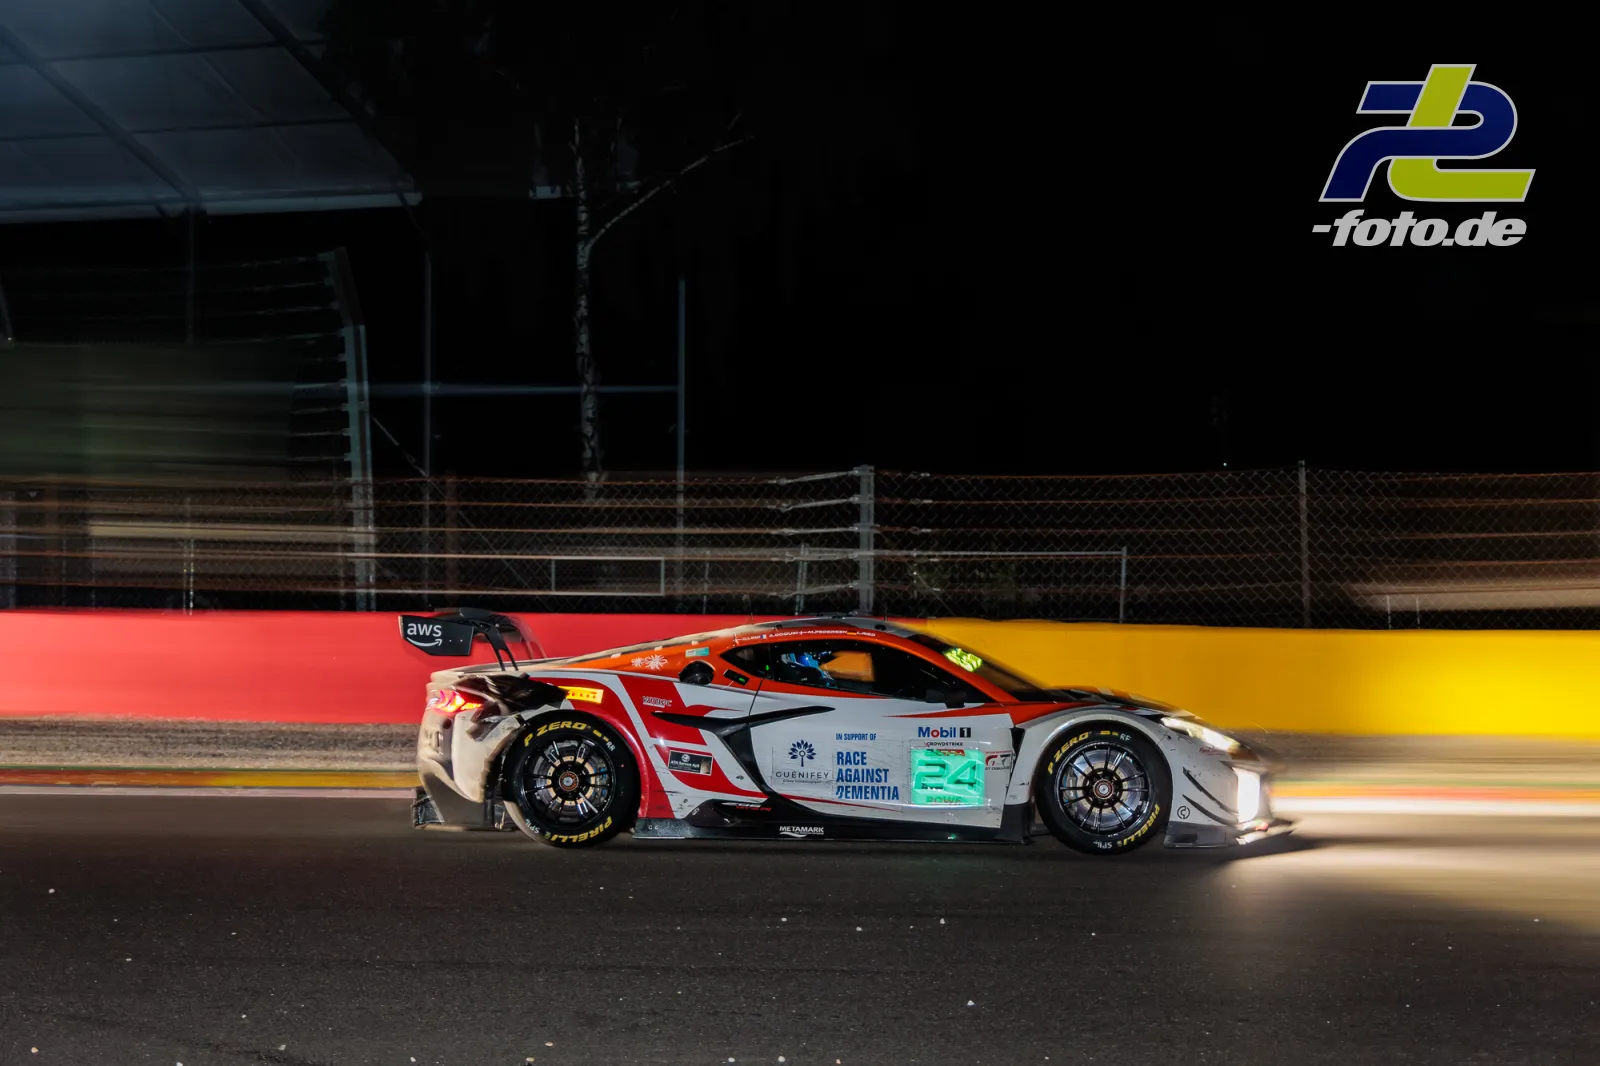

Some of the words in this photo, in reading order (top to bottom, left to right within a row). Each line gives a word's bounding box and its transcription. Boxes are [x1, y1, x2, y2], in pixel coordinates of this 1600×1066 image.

[407, 623, 442, 637] aws
[536, 721, 588, 737] ZERO
[918, 726, 956, 738] Mobil
[961, 727, 971, 738] 1
[1053, 731, 1089, 762] ZERO
[836, 751, 867, 766] RACE
[836, 768, 889, 783] AGAINST
[913, 759, 976, 790] 24
[836, 785, 899, 801] DEMENTIA
[550, 816, 612, 843] PIRELLI
[779, 825, 824, 833] METAMARK
[1123, 804, 1160, 846] PIRELLI
